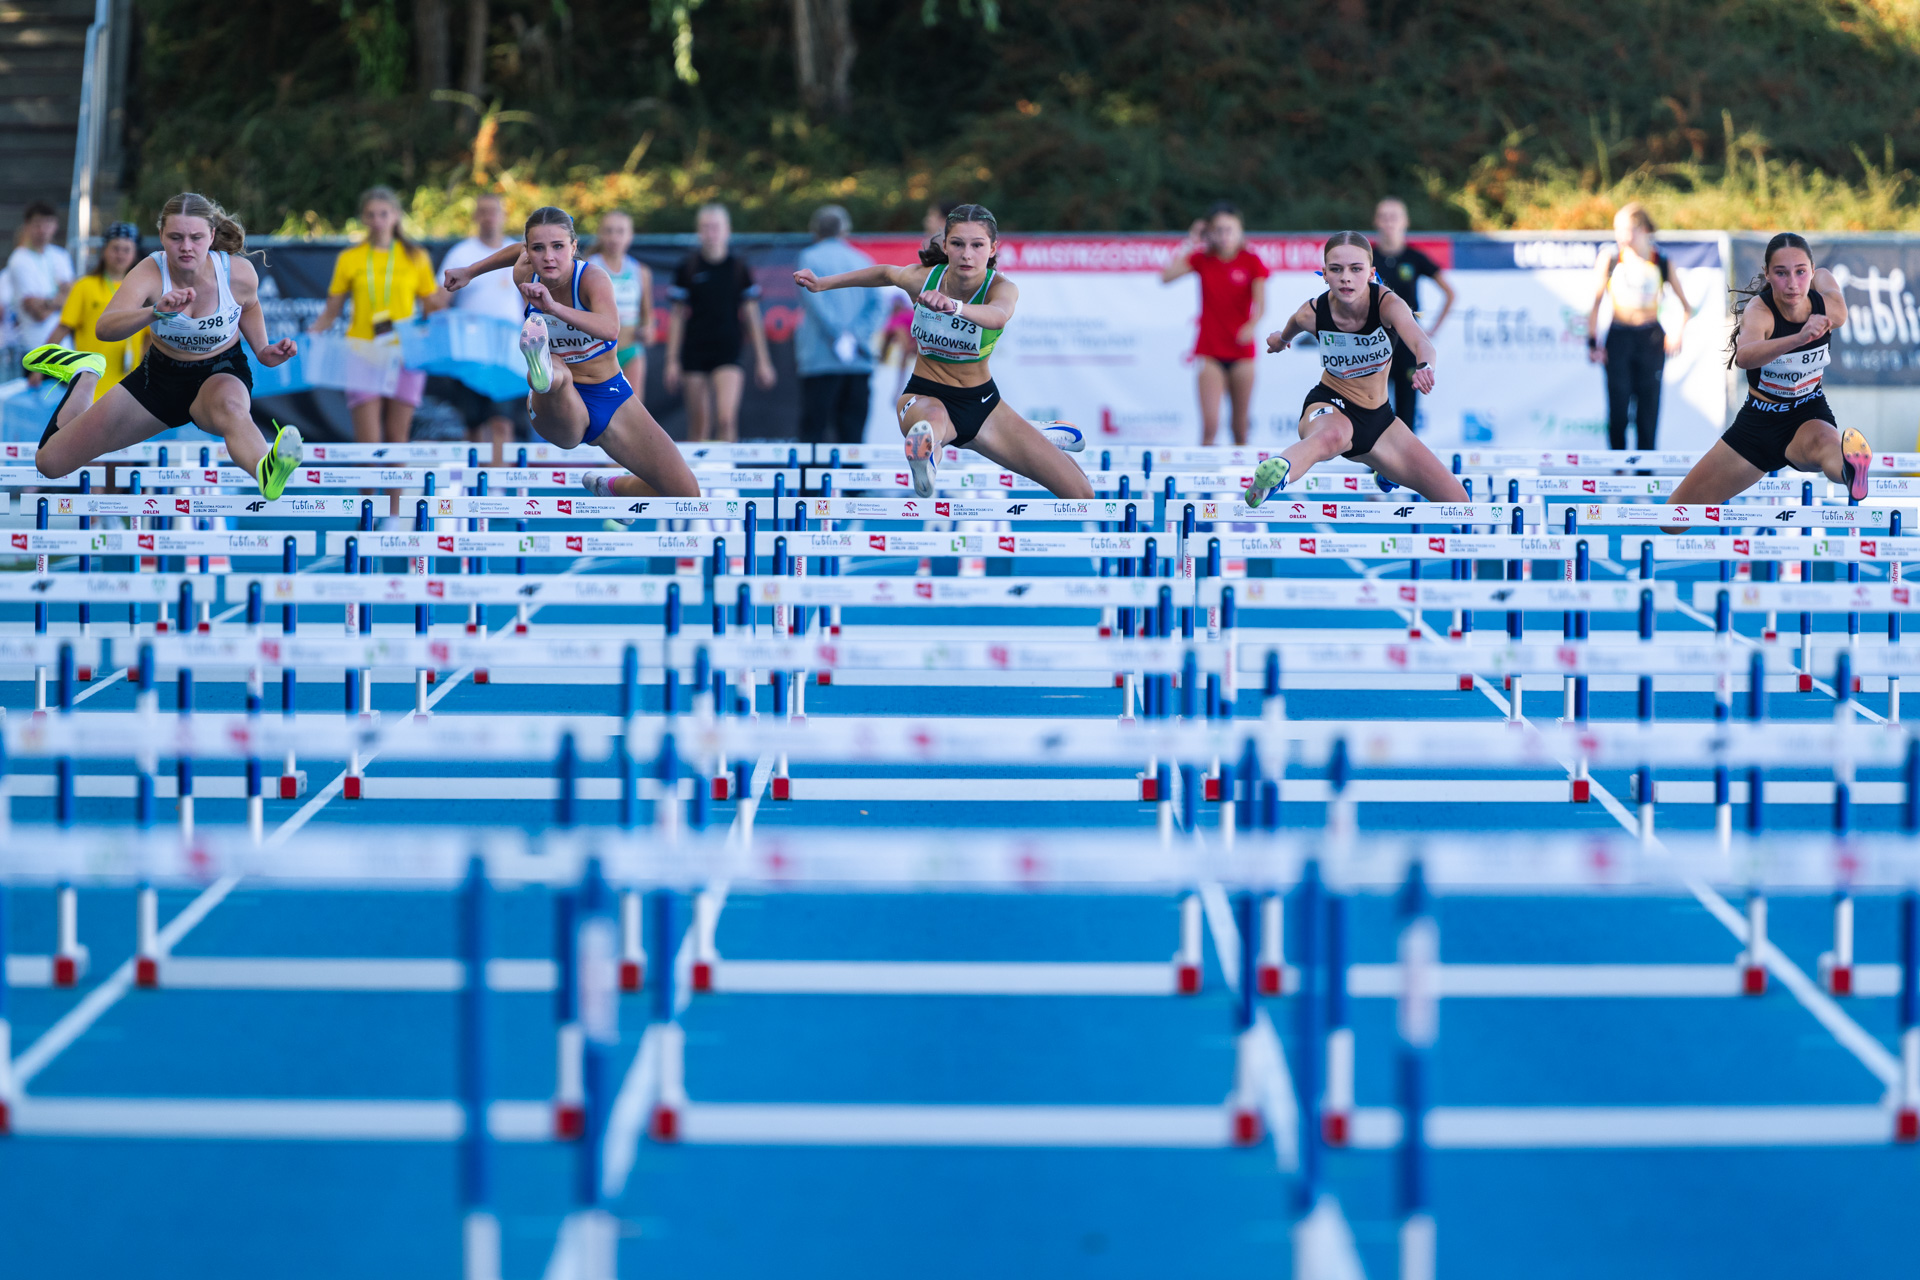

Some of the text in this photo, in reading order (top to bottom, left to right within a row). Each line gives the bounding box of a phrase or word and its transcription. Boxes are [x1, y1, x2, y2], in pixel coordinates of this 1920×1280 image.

[1834, 263, 1920, 345] lubli
[198, 316, 224, 330] 298
[950, 318, 977, 334] 873
[548, 337, 595, 348] LEWIA
[912, 324, 978, 352] KUŁAKOWSKA
[1353, 331, 1386, 347] 1028
[1322, 347, 1390, 368] POPŁAWSKA
[1802, 349, 1825, 364] 877
[1752, 398, 1790, 412] NIKE
[246, 501, 267, 512] 4F
[292, 500, 314, 510] lublin
[628, 502, 650, 513] 4F
[675, 502, 697, 512] lublin
[1006, 504, 1028, 515] 4F
[1054, 503, 1076, 512] lublin
[1394, 506, 1415, 517] 4F
[1440, 506, 1462, 516] lublin
[1776, 510, 1797, 521] 4F
[1821, 511, 1843, 520] lublin
